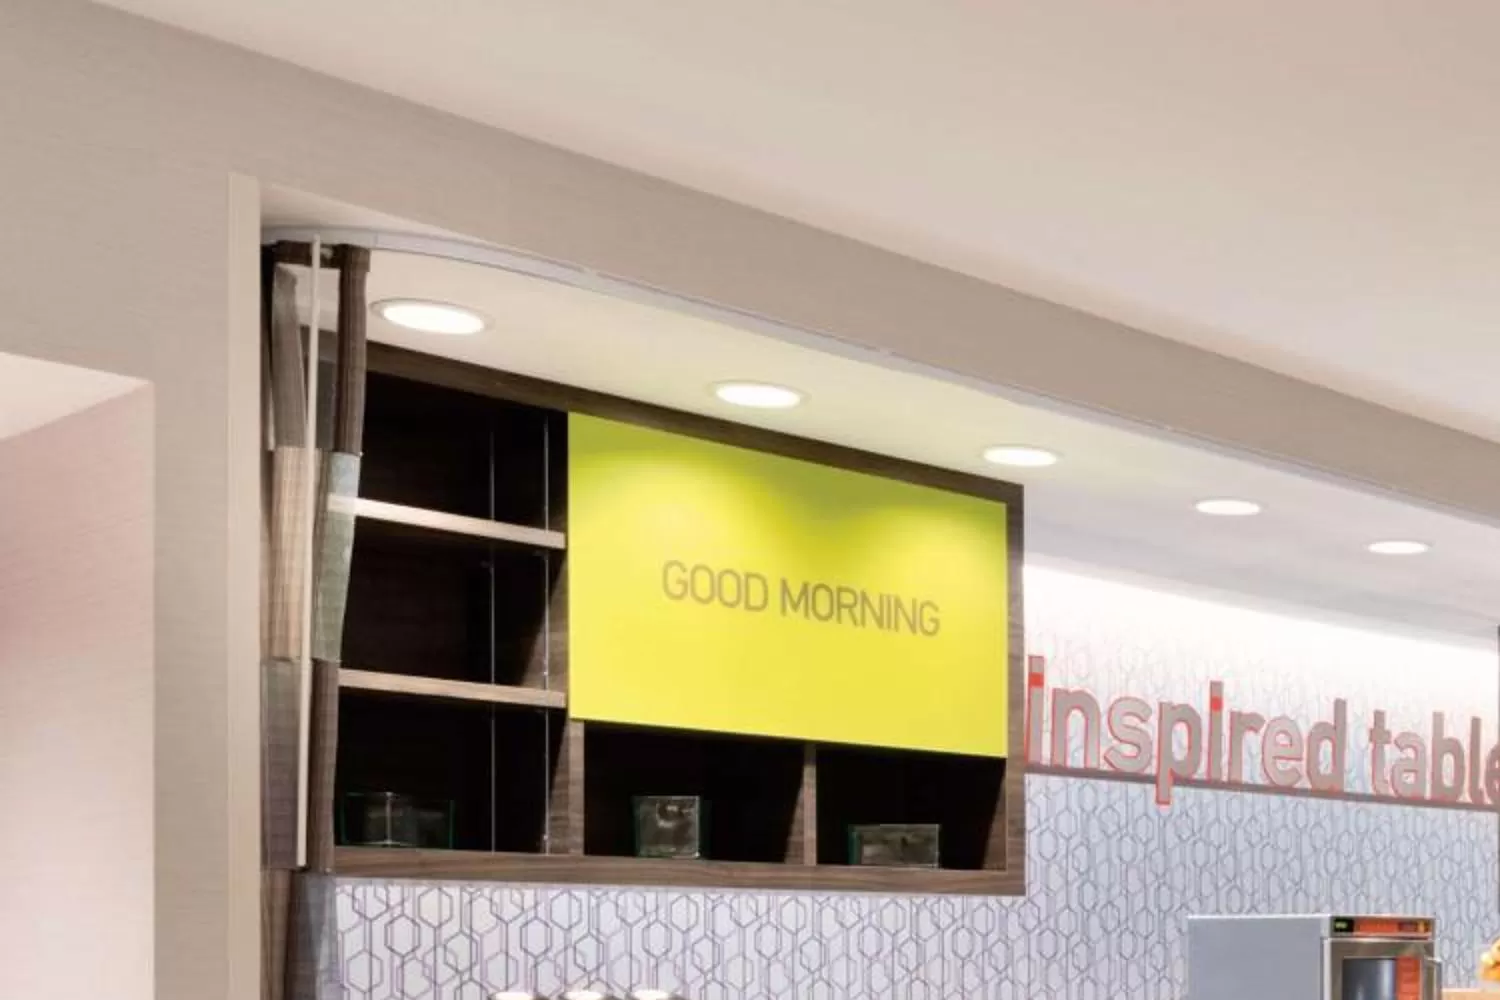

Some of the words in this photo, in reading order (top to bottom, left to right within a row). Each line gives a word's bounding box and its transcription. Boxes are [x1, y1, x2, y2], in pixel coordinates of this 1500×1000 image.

[661, 559, 769, 612] GOOD
[779, 577, 940, 636] MORNING
[1025, 655, 1347, 807] inspired
